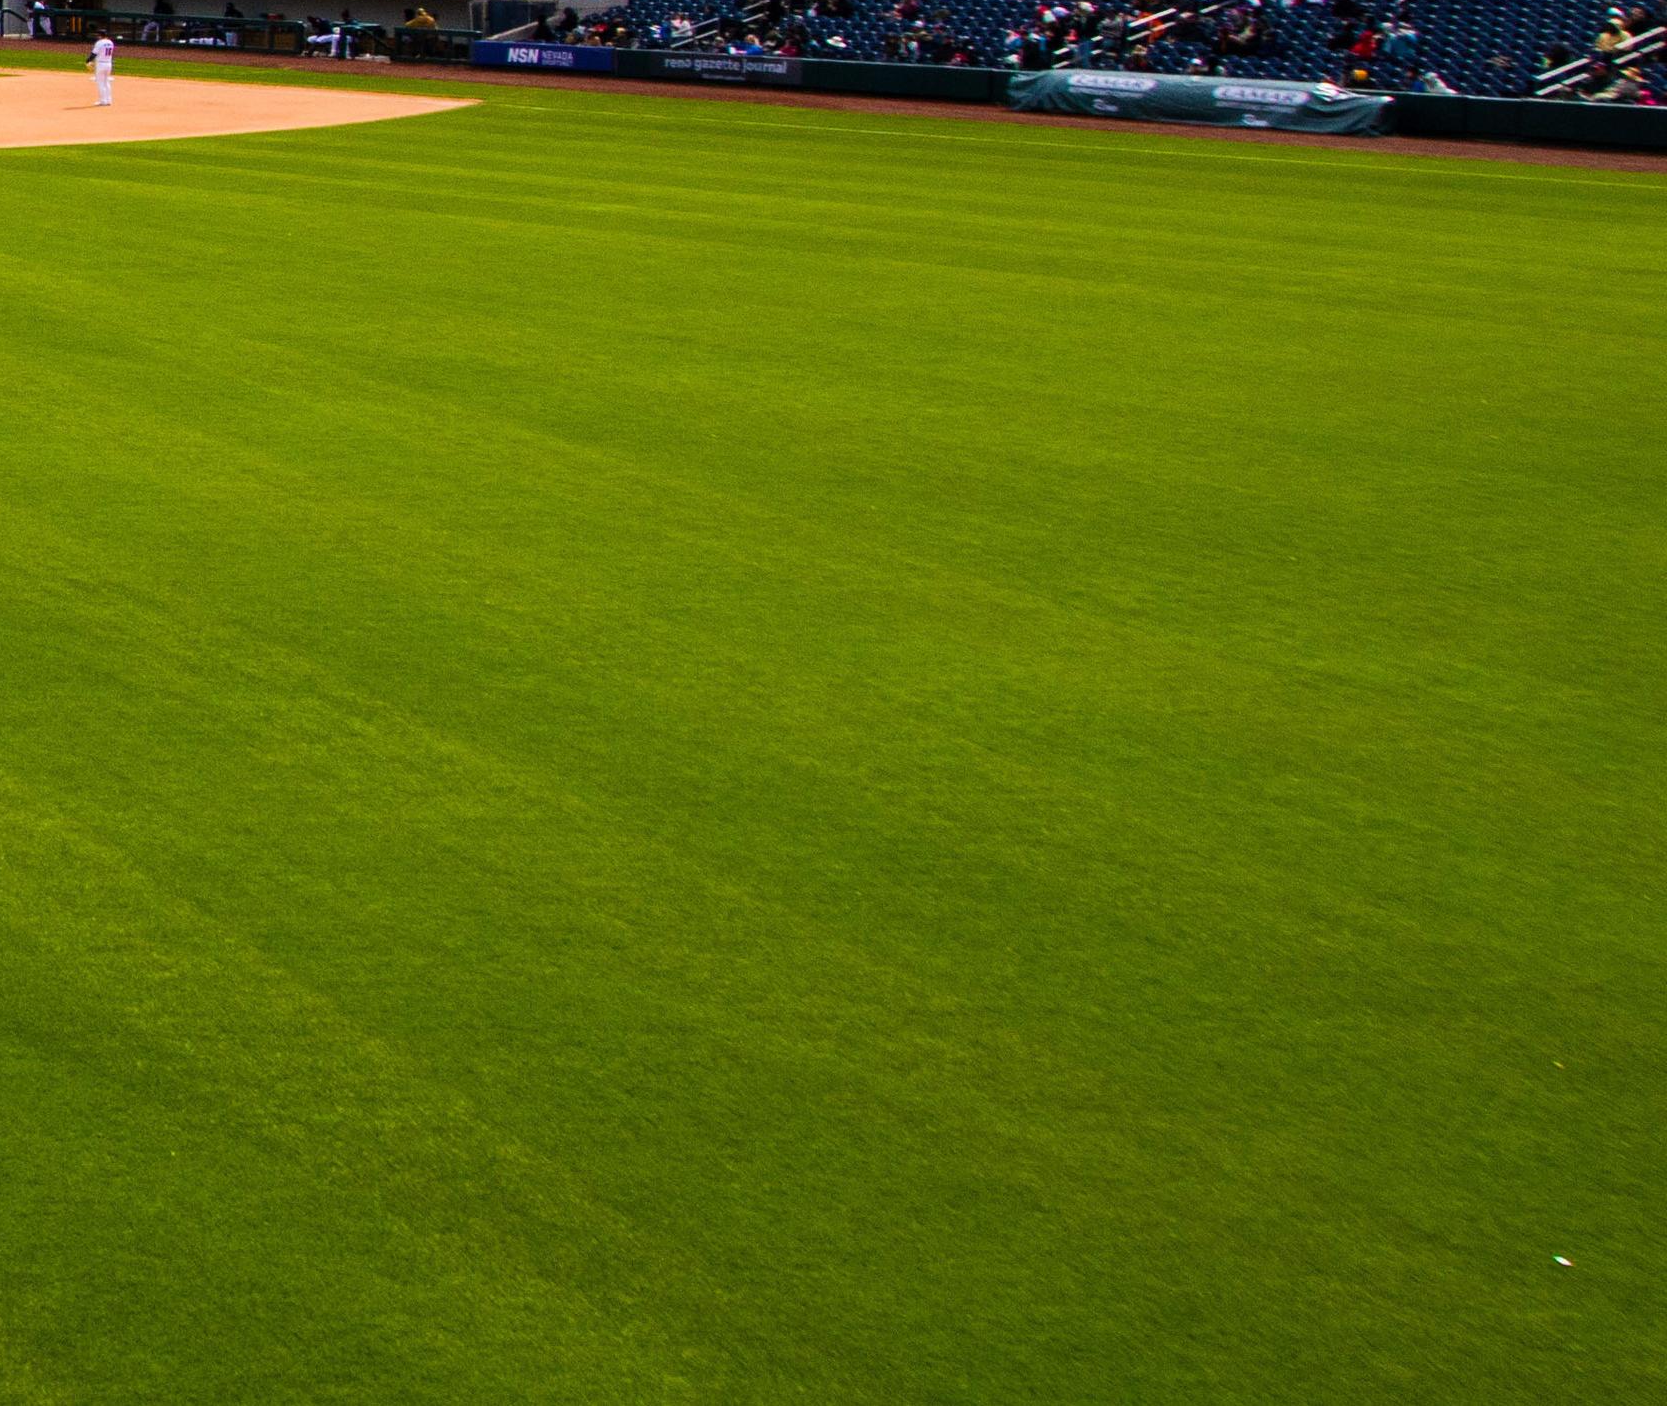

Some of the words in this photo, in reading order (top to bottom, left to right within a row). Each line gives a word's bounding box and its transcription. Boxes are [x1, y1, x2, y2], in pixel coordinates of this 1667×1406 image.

[507, 47, 539, 63] NSN
[664, 58, 692, 69] reno
[694, 58, 741, 72] gazette
[742, 58, 787, 74] journal
